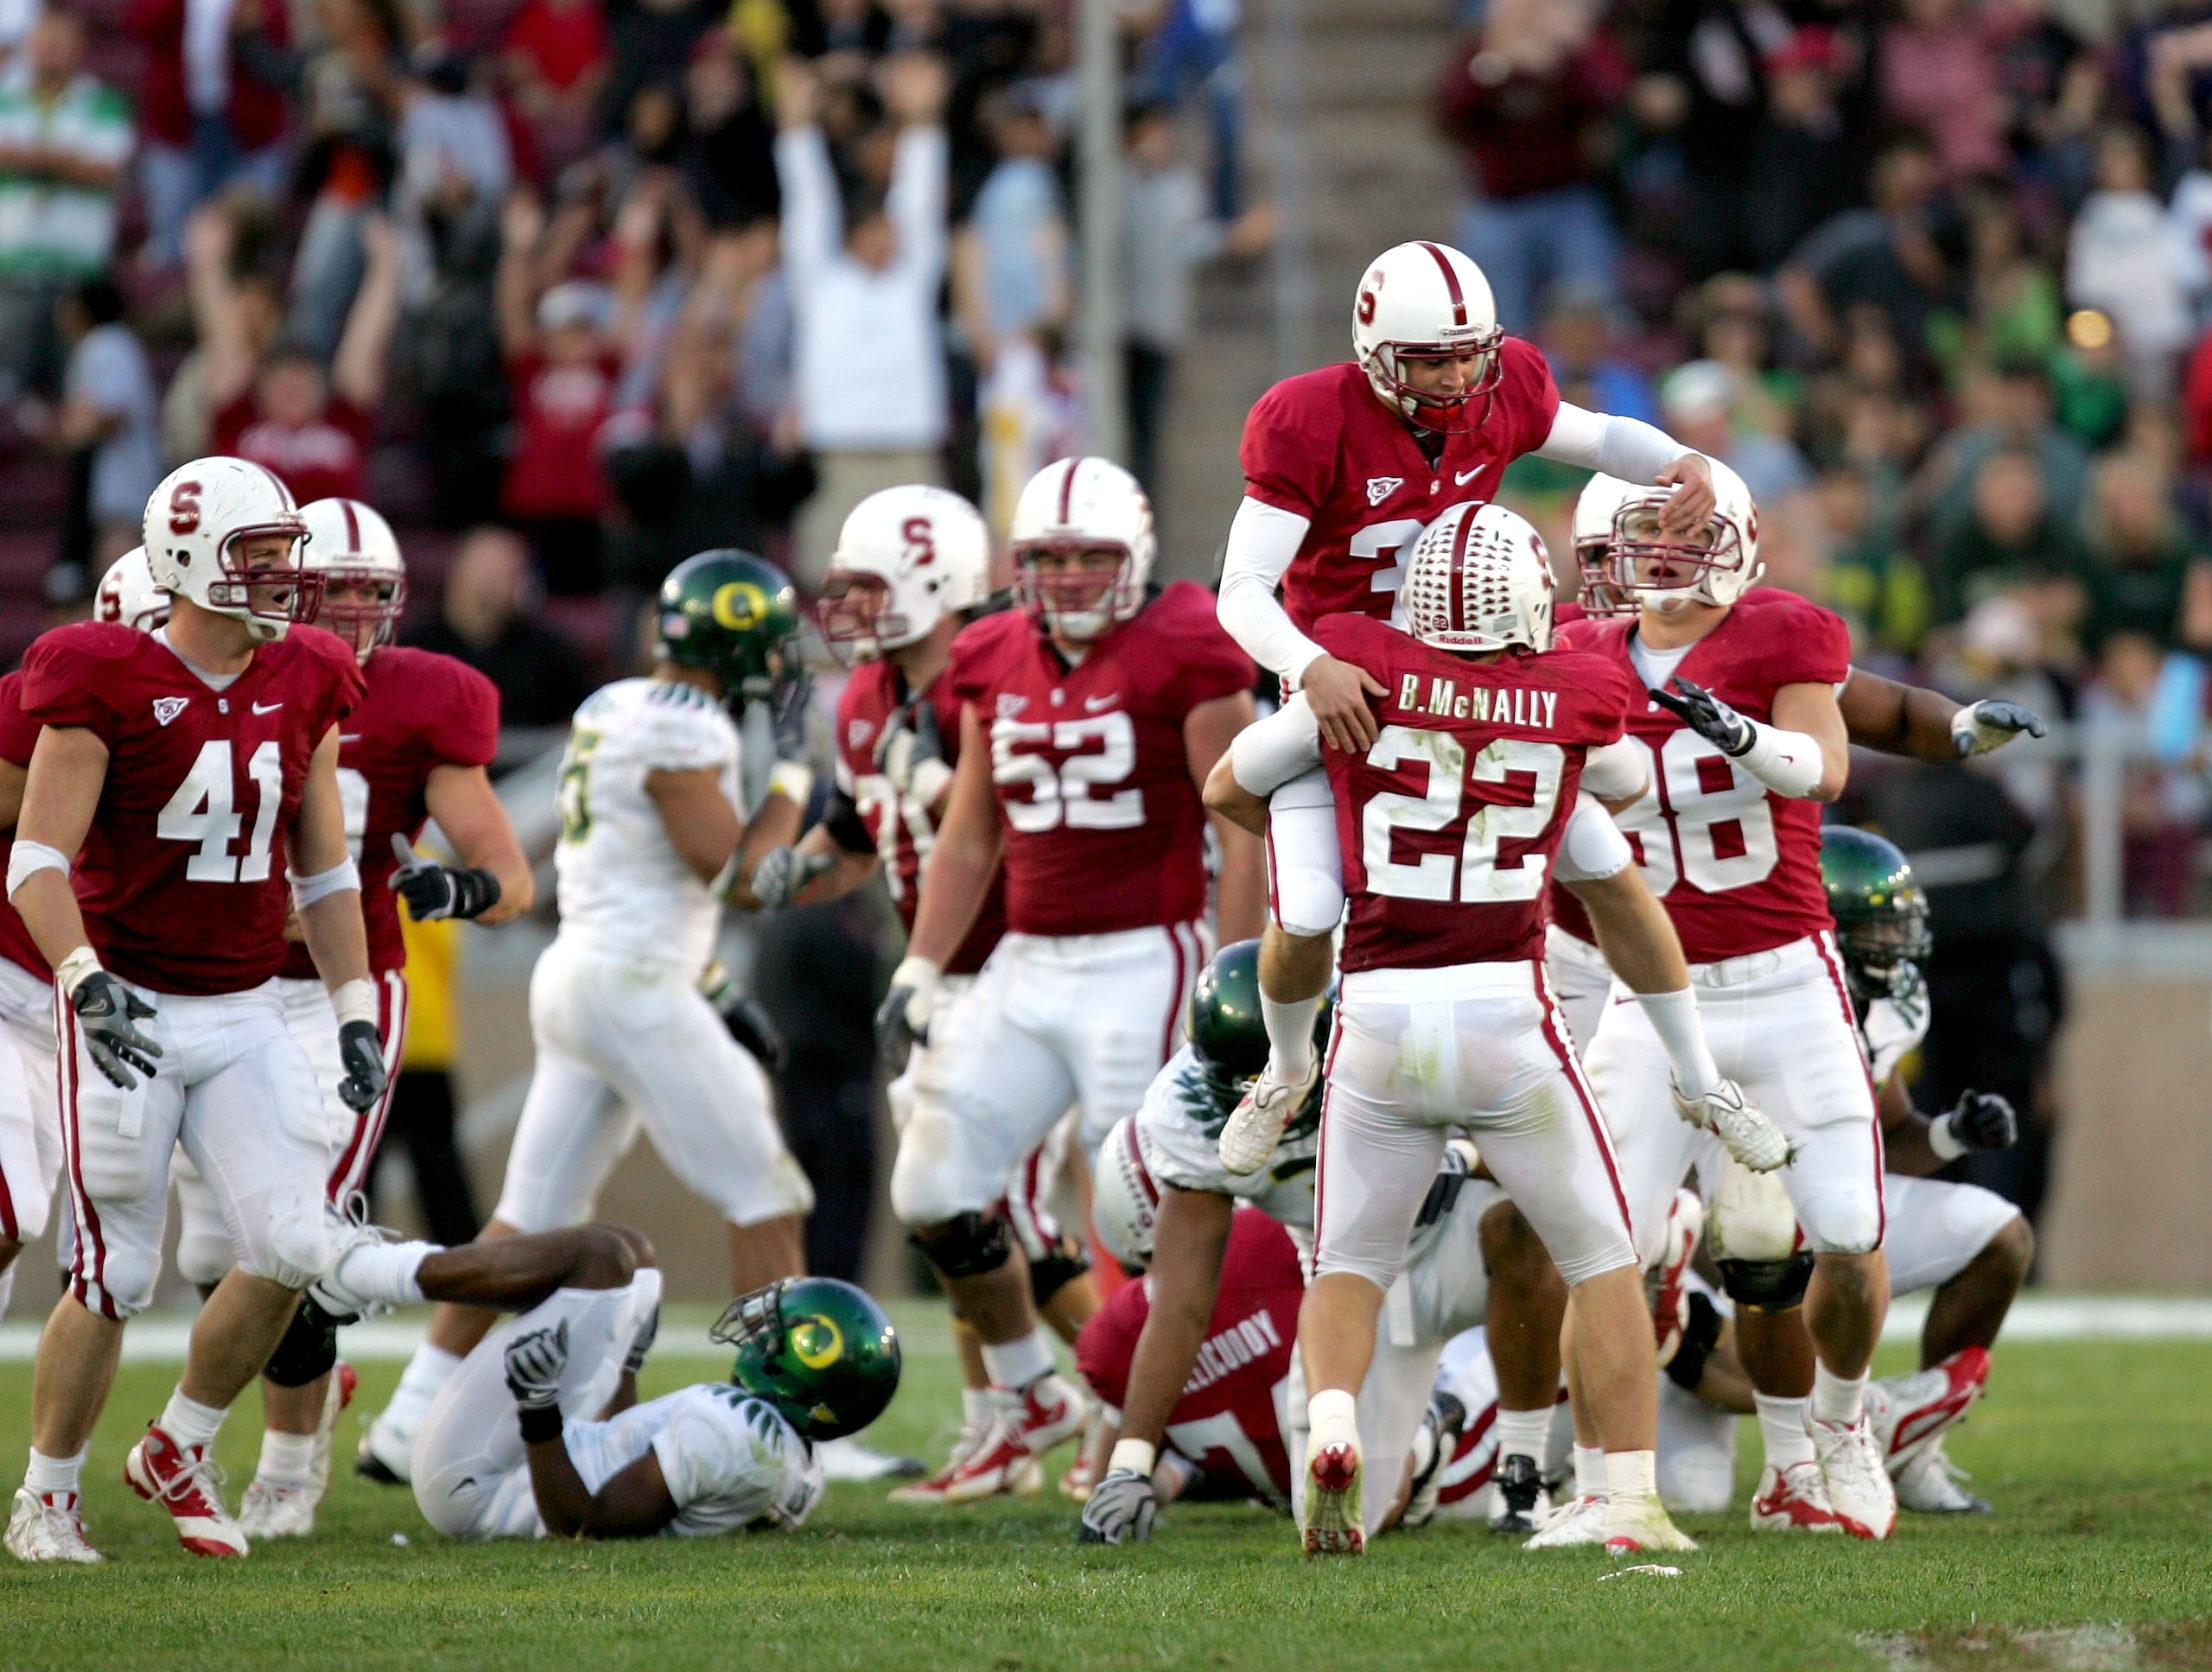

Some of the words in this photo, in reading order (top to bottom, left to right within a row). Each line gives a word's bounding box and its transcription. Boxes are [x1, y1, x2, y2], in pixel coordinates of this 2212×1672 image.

[1357, 269, 1385, 327] S
[168, 480, 201, 536] S
[901, 516, 935, 566] S
[102, 571, 121, 621] S
[712, 581, 769, 630] O
[1433, 616, 1447, 630] 22
[1439, 634, 1484, 645] Riddell
[1398, 673, 1557, 728] B.McNALLY
[991, 710, 1147, 832] 52
[156, 740, 283, 882] 41
[1363, 724, 1566, 903] 22
